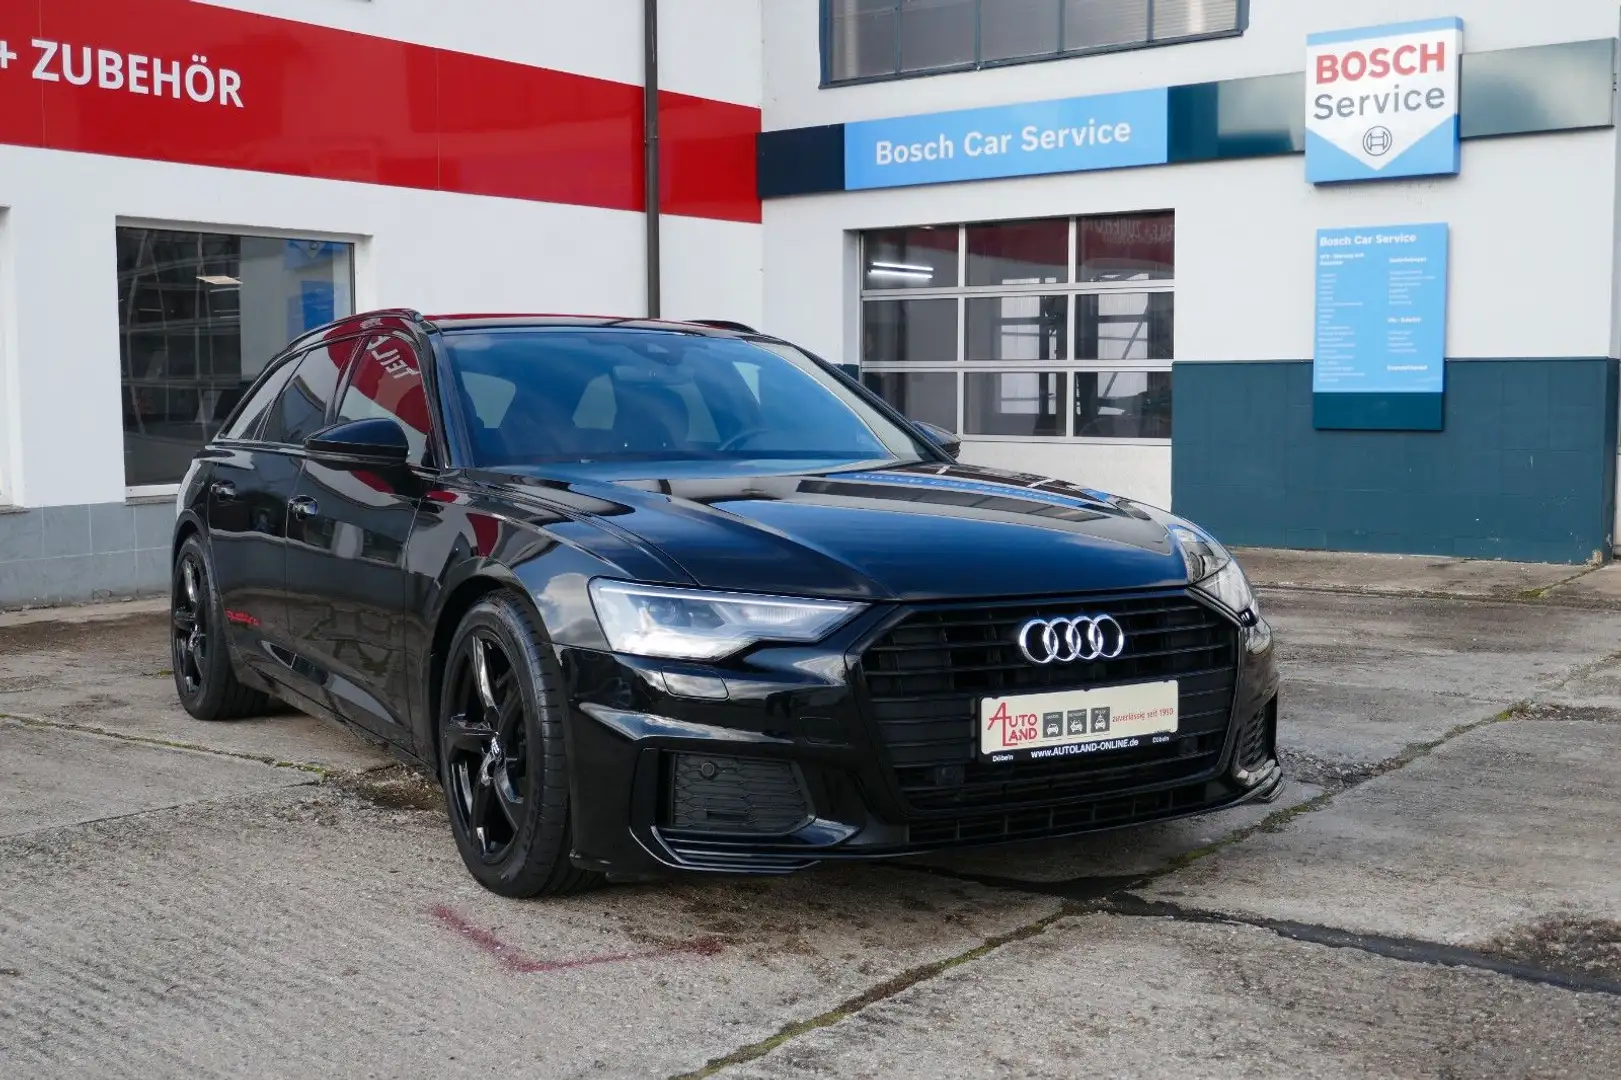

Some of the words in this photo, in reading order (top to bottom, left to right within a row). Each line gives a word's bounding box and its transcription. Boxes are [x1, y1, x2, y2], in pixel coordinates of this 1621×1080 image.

[31, 38, 244, 108] ZUBEHÖR
[1316, 41, 1445, 85] BOSCH
[1313, 84, 1445, 120] Service
[876, 133, 954, 165] Bosch
[964, 131, 1012, 156] Car
[1021, 118, 1131, 151] Service
[1319, 235, 1351, 247] Bosch
[1354, 235, 1372, 245] Car
[1375, 232, 1417, 244] Service
[987, 702, 1038, 731] AUTO
[1003, 722, 1038, 747] LAND
[1031, 738, 1139, 758] www.AUTOLAND-ONLINE.de
